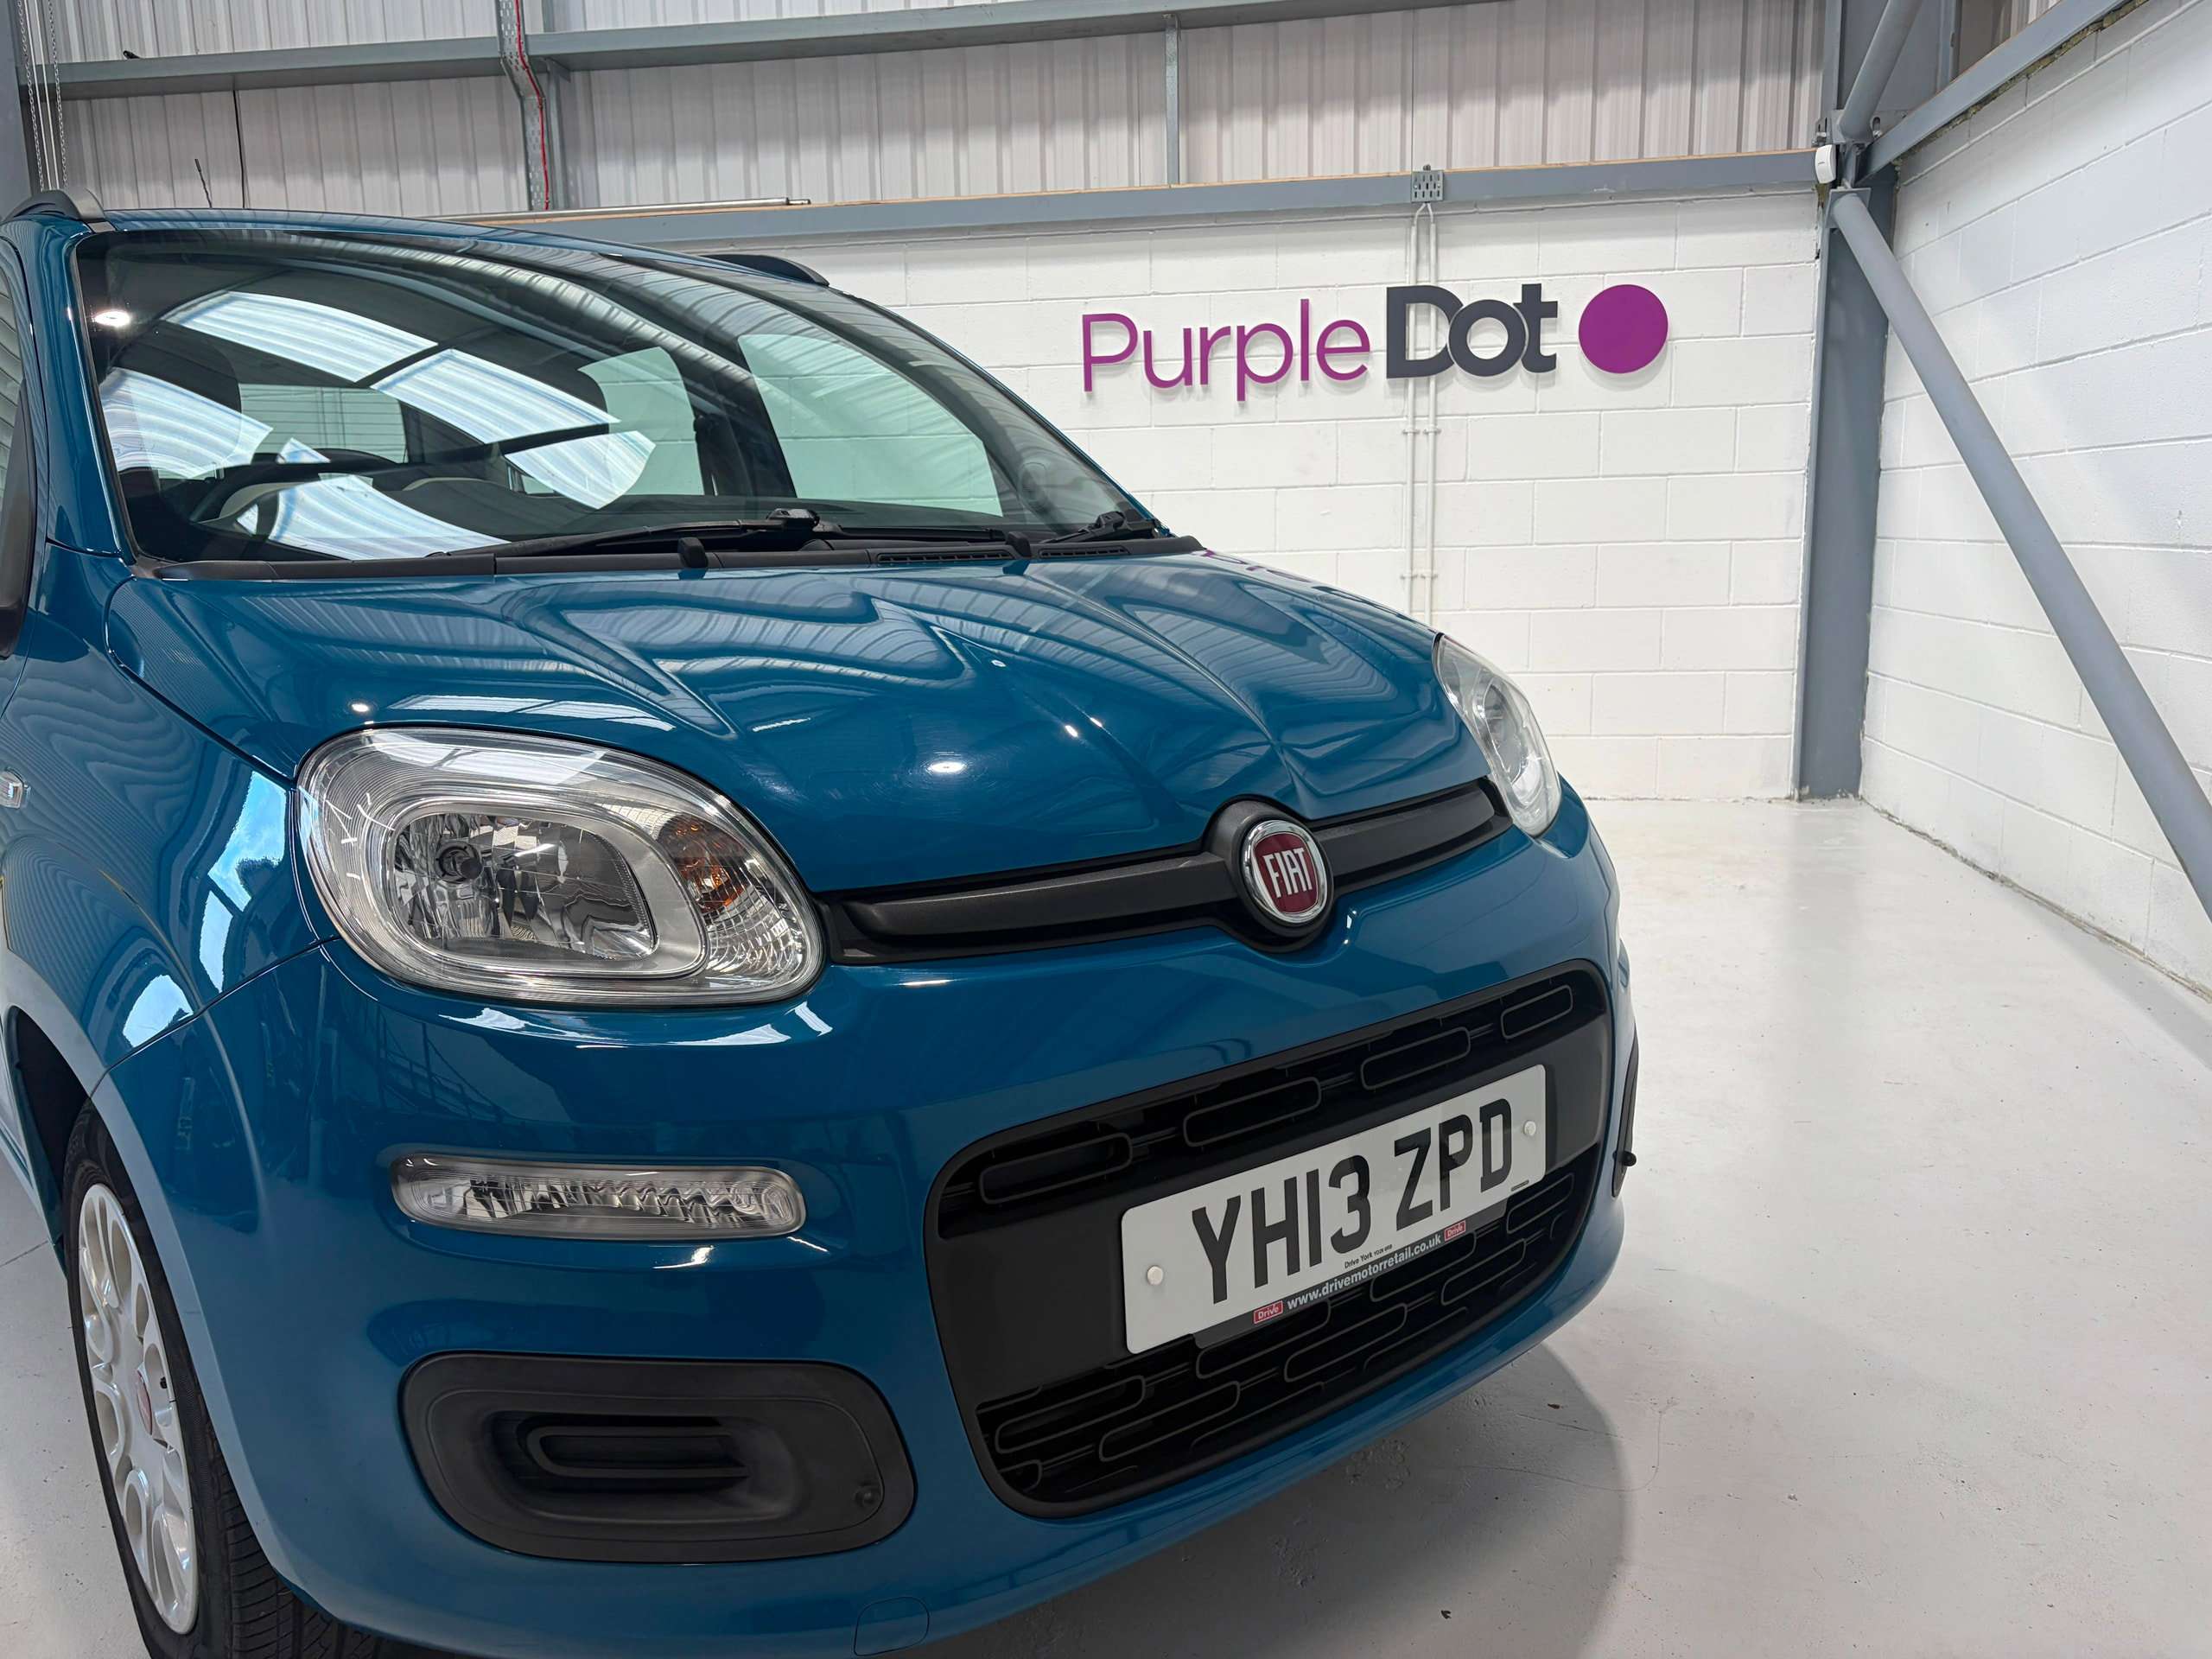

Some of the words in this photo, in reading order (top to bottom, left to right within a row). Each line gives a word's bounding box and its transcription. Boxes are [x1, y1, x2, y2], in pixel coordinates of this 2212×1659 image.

[1082, 297, 1371, 403] Purple
[1386, 283, 1558, 379] Dot
[1262, 847, 1313, 899] FIAT
[1192, 1154, 1371, 1305] YH13
[1394, 1097, 1512, 1231] ZPD
[1257, 1303, 1279, 1320] Drive
[1287, 1233, 1441, 1310] www.drivemotorretail.co.uk
[1344, 1258, 1360, 1269] Drive
[1360, 1251, 1373, 1262] York
